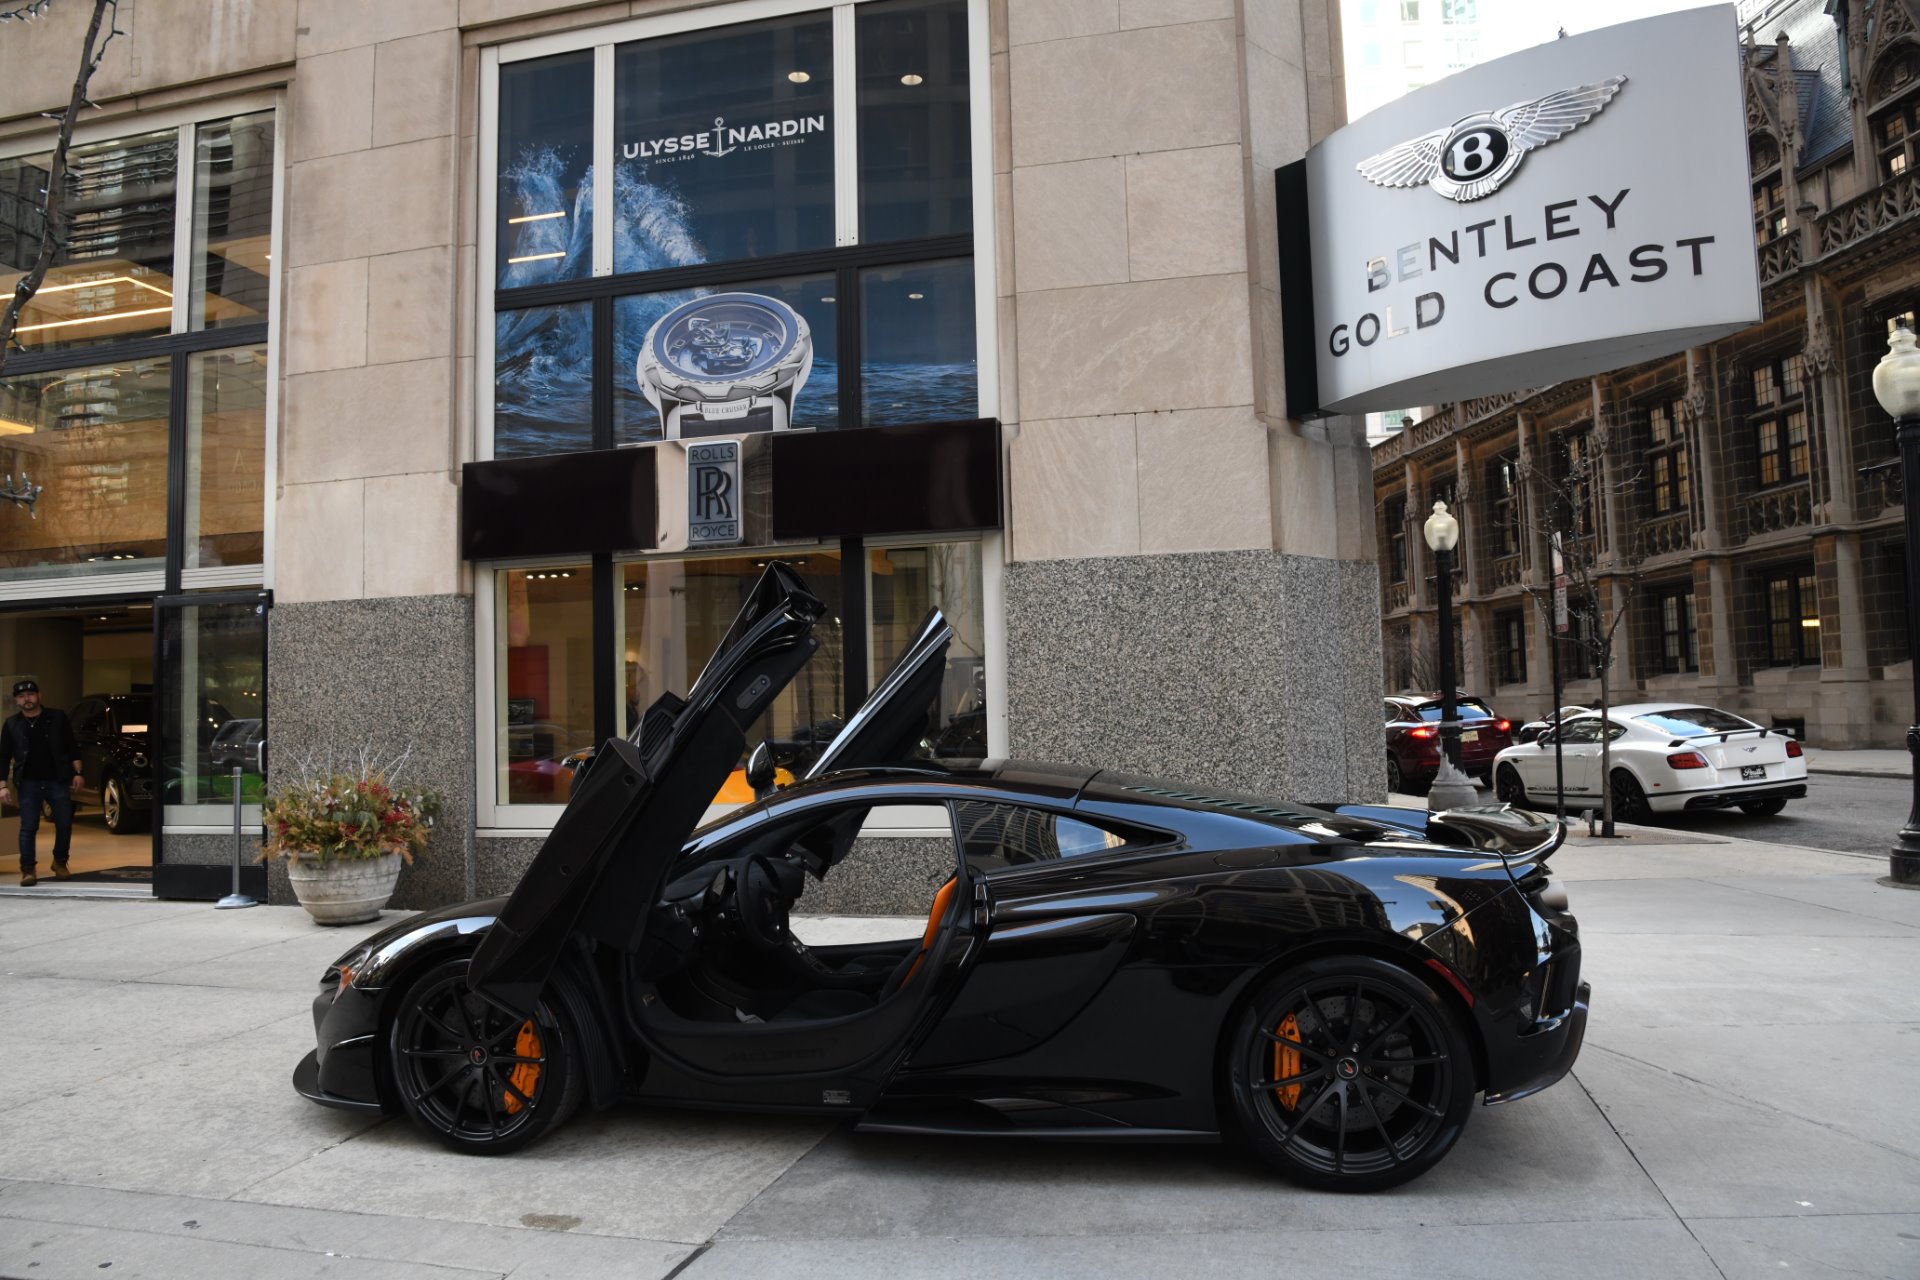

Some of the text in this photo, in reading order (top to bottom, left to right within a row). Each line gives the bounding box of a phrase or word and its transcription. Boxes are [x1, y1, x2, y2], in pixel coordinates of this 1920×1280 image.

[623, 115, 825, 159] ULYSSE NARDIN
[1366, 188, 1631, 293] BENTLEY
[1329, 235, 1716, 357] GOLD COAST
[691, 446, 734, 461] ROLLS
[692, 524, 735, 538] ROYCE
